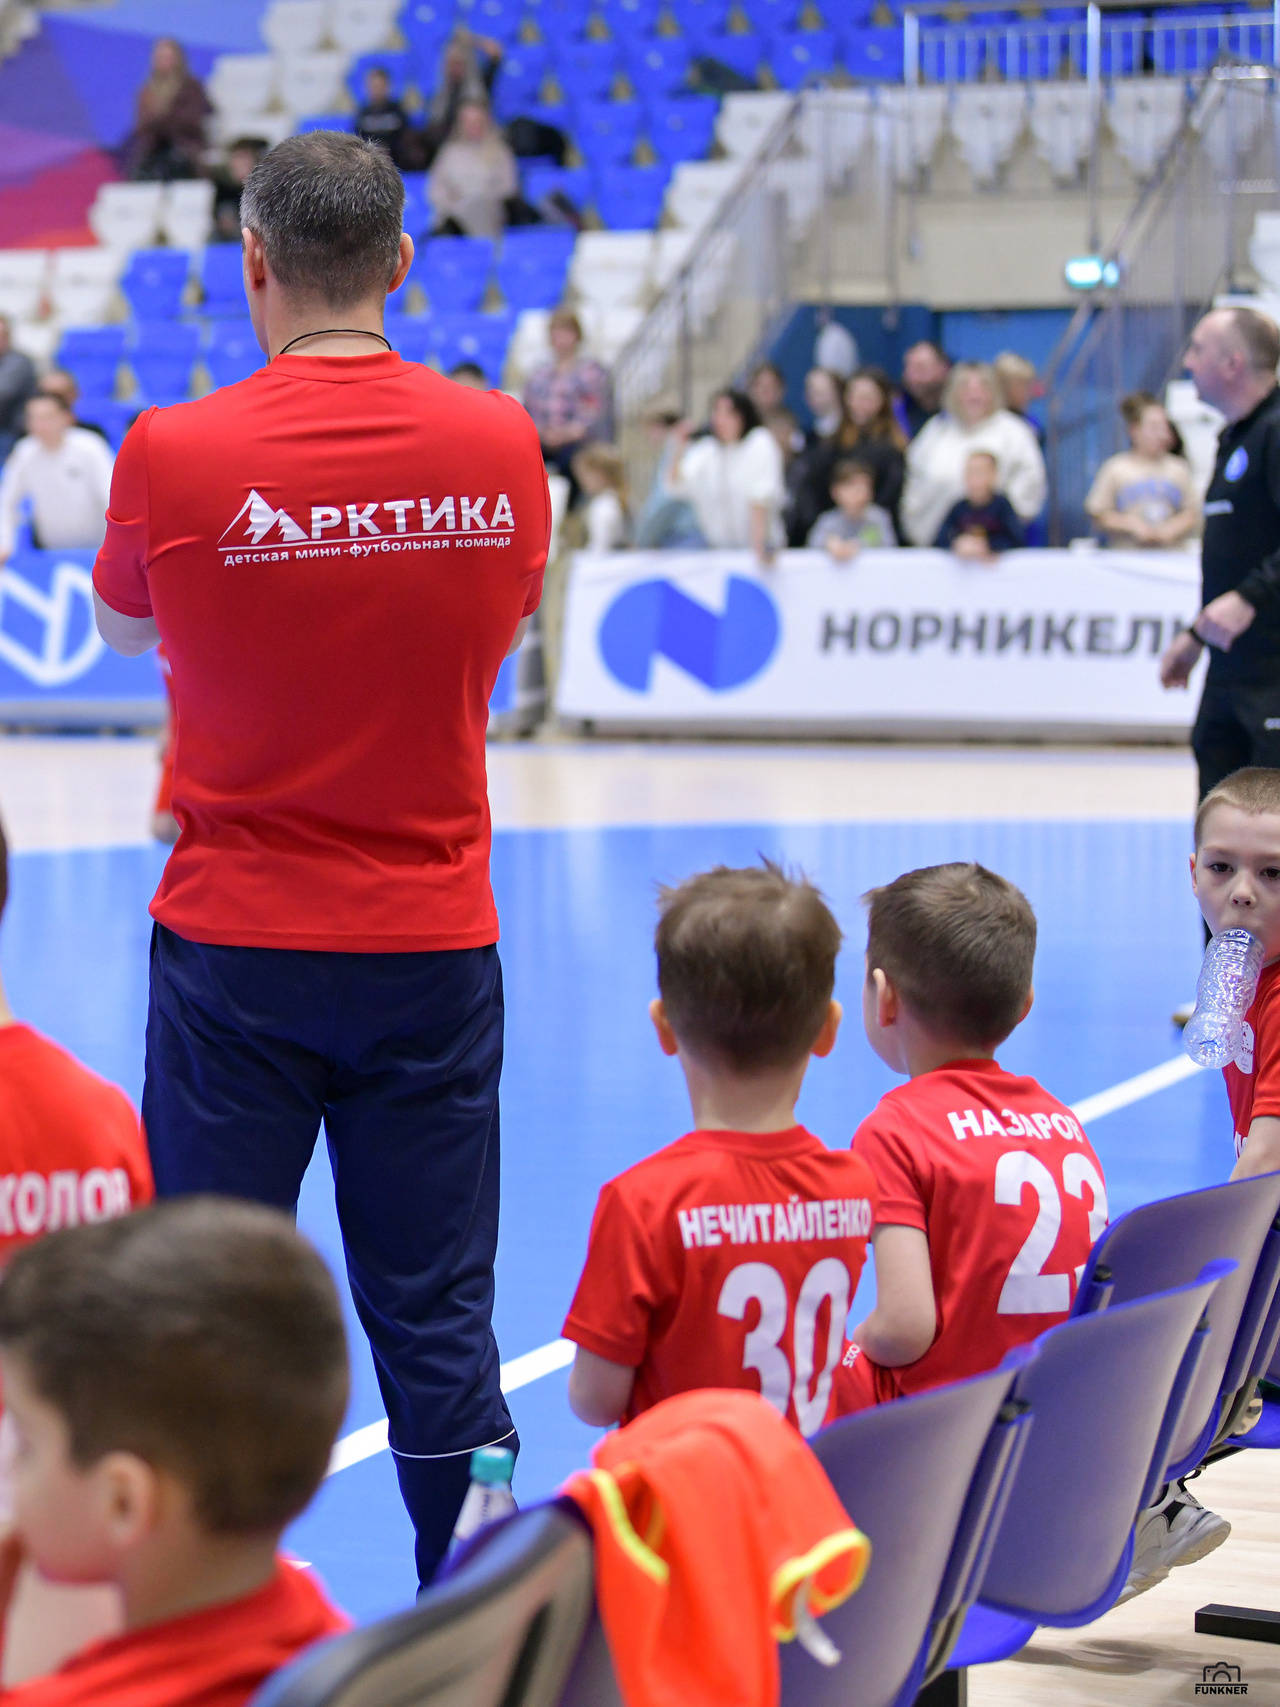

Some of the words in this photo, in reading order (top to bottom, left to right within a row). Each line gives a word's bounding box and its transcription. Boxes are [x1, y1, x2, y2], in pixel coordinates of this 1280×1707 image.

[224, 551, 289, 566] детская
[295, 539, 450, 559] мини-футбольная
[455, 536, 511, 548] команда
[947, 1109, 1083, 1143] НАЗАРОВ
[678, 1194, 872, 1249] НЕЧИТАЙЛЕНКО
[717, 1257, 851, 1438] 30
